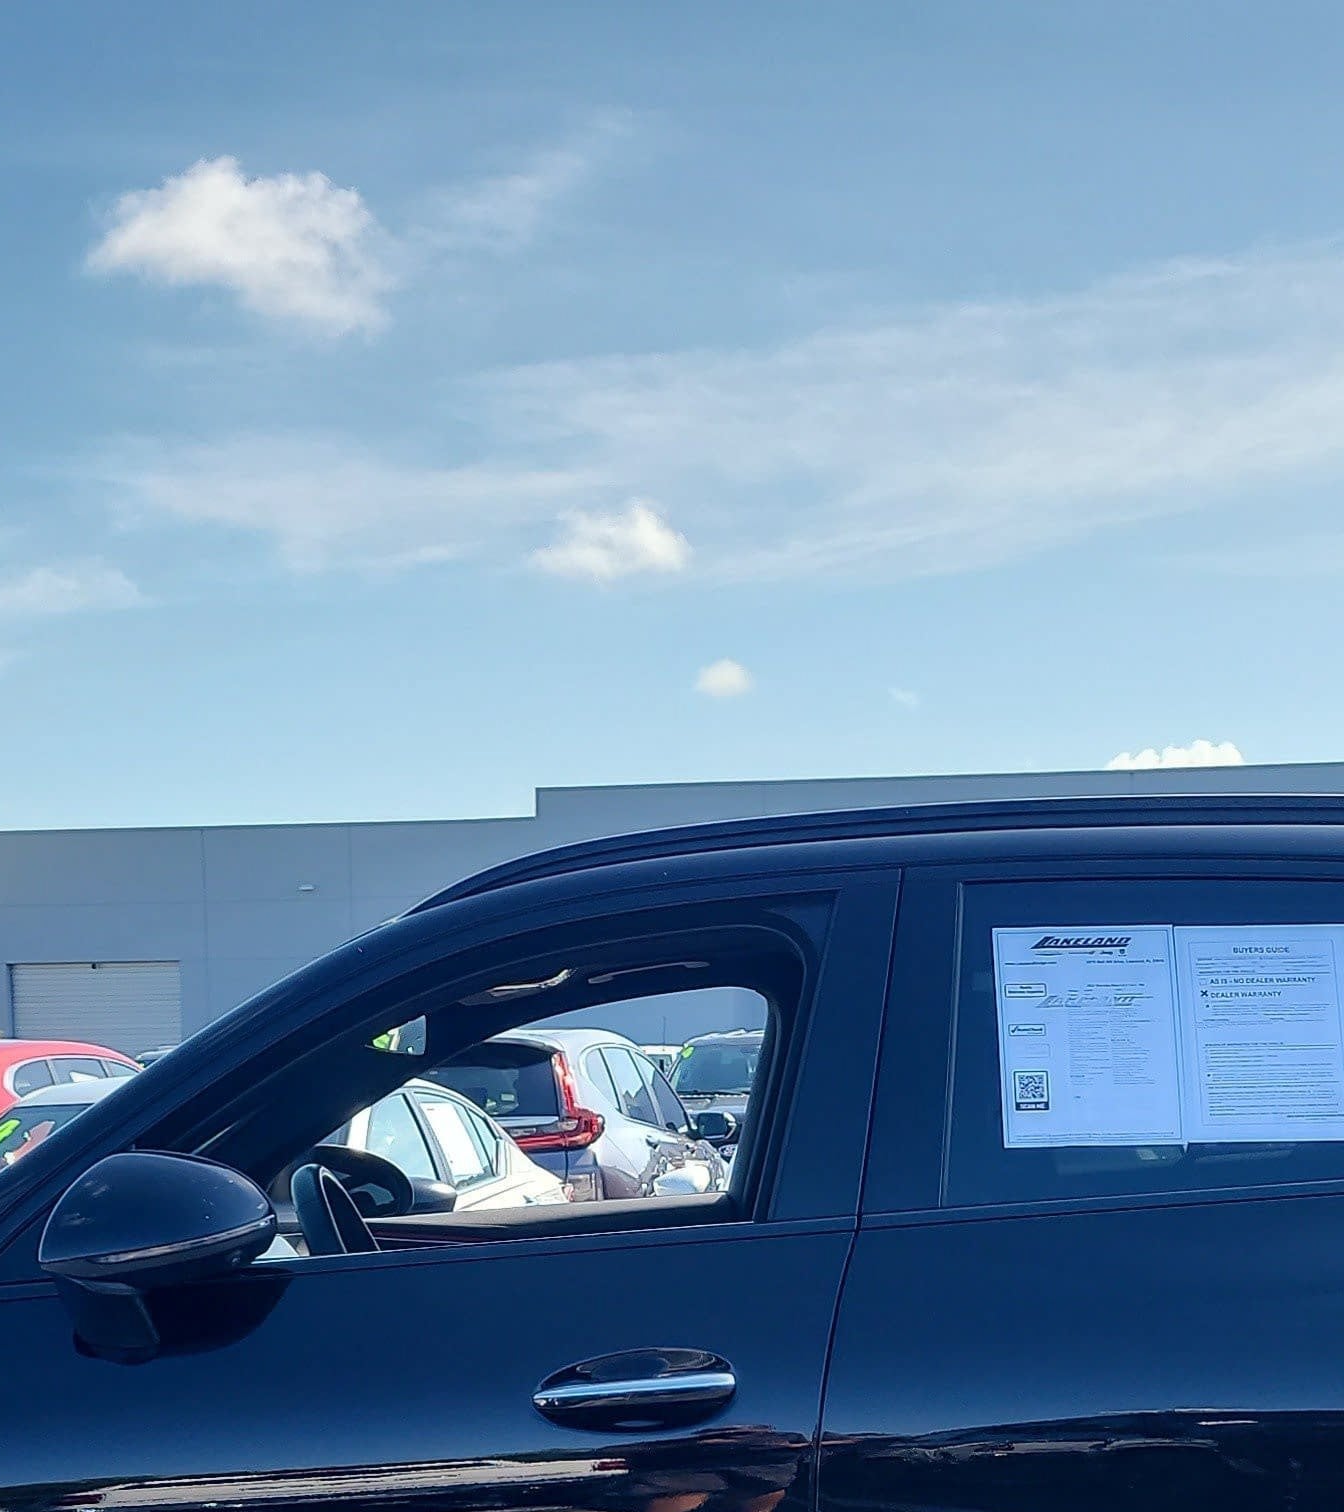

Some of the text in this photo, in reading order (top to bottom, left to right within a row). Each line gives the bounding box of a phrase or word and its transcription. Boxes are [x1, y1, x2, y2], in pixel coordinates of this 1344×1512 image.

[1031, 936, 1133, 950] LAKELAND
[1232, 946, 1290, 954] BUYERS GUIDE
[1275, 976, 1316, 984] WARRANTY
[1210, 990, 1282, 999] DEALER WARRANTY
